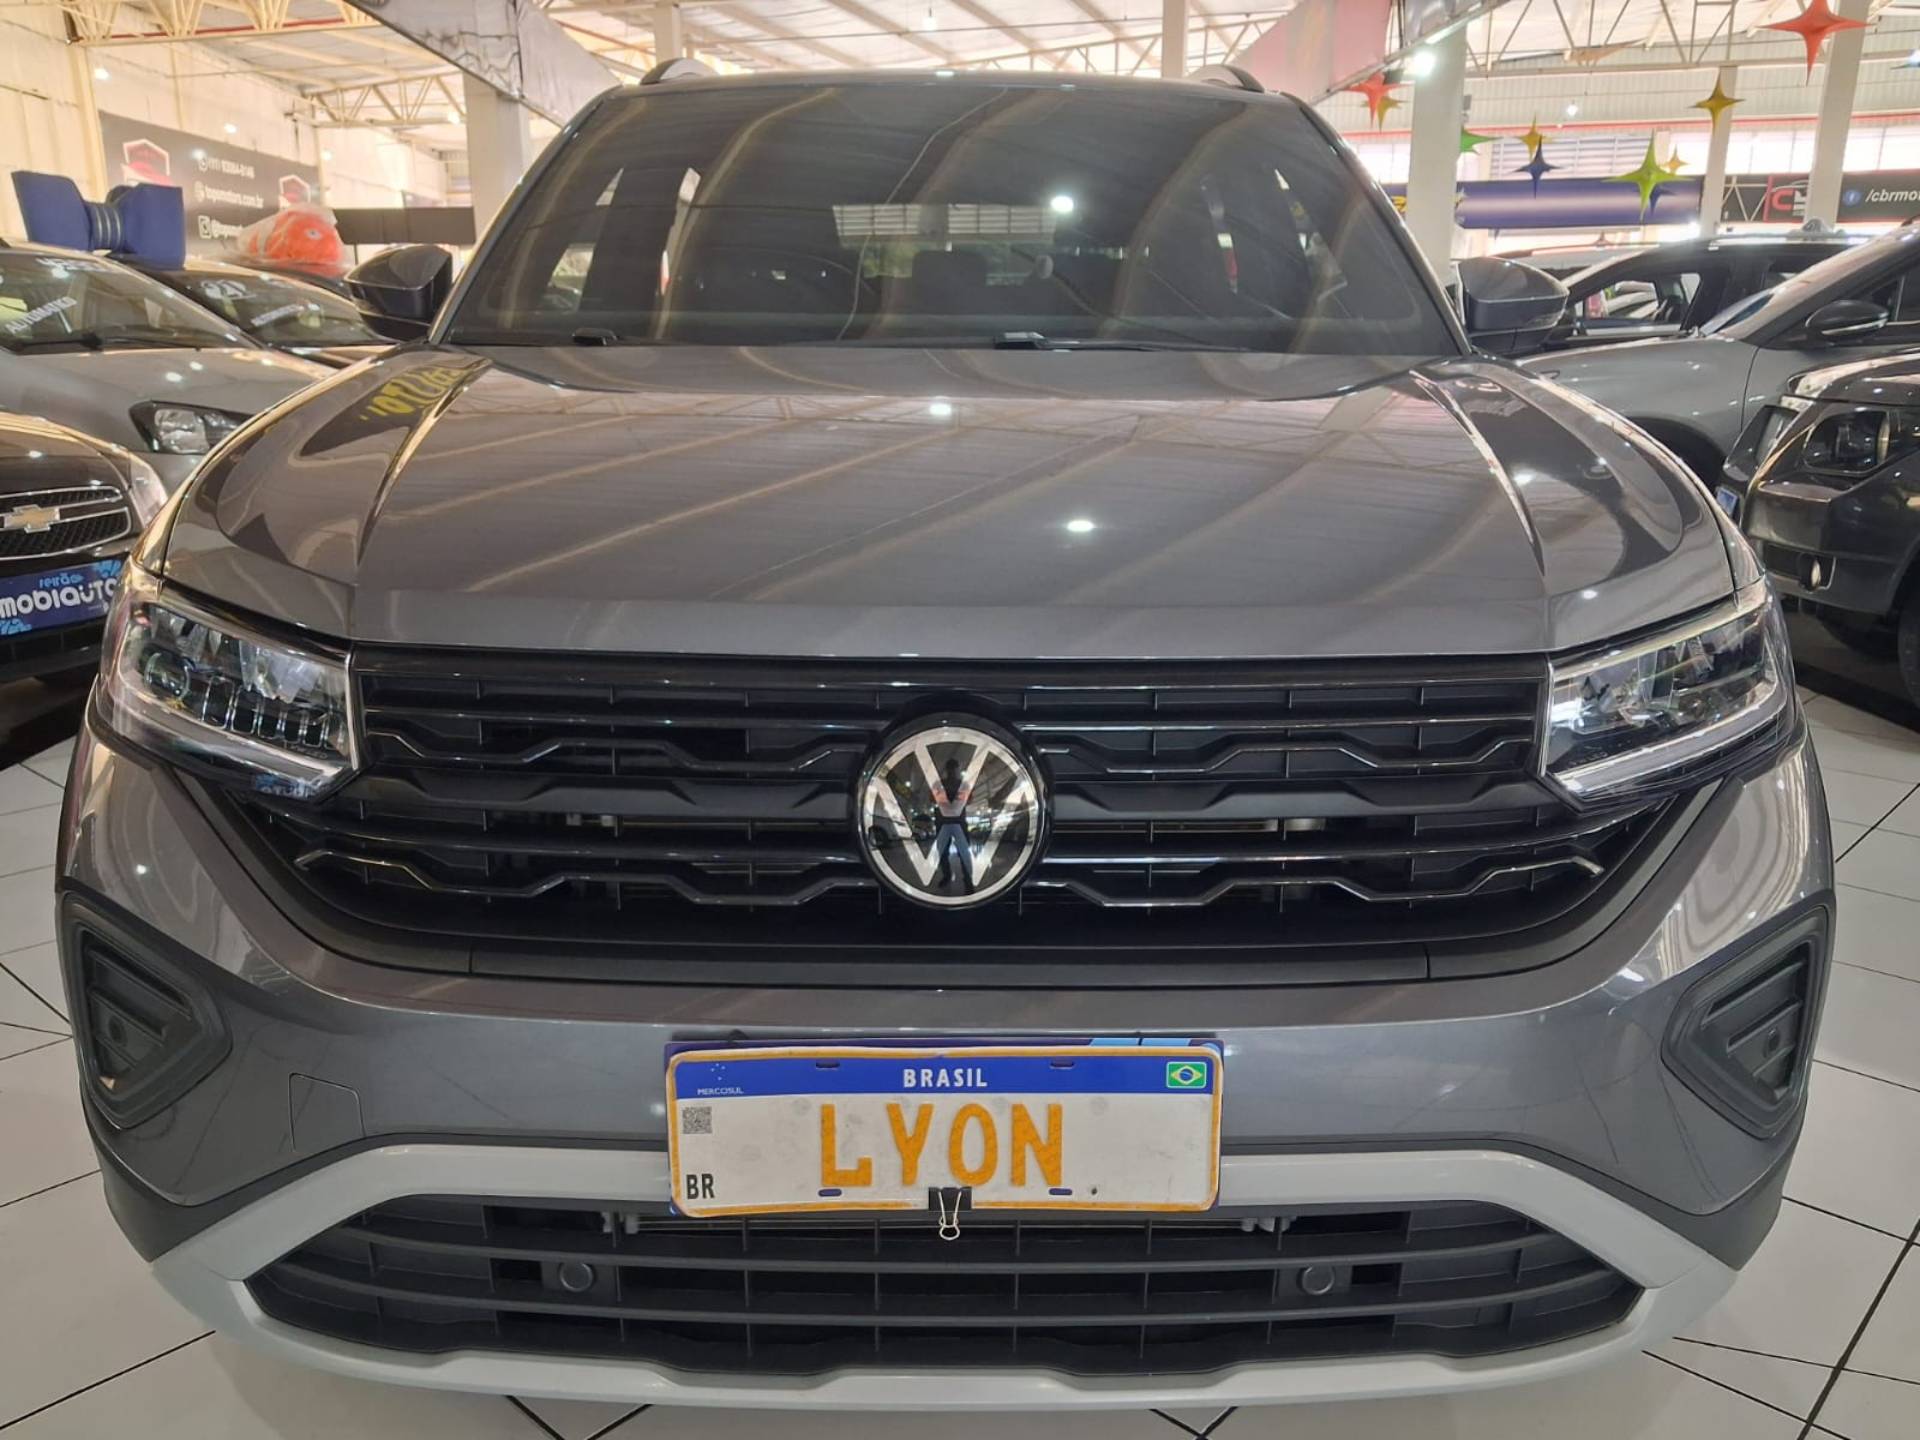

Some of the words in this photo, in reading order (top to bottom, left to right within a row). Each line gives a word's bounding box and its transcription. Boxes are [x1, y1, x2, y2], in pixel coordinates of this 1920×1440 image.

[1865, 189, 1920, 202] /cbrmo
[903, 1068, 988, 1088] BRASIL
[697, 1086, 745, 1096] MERCOSUL
[819, 1103, 1064, 1188] LYON
[686, 1173, 715, 1200] BR
